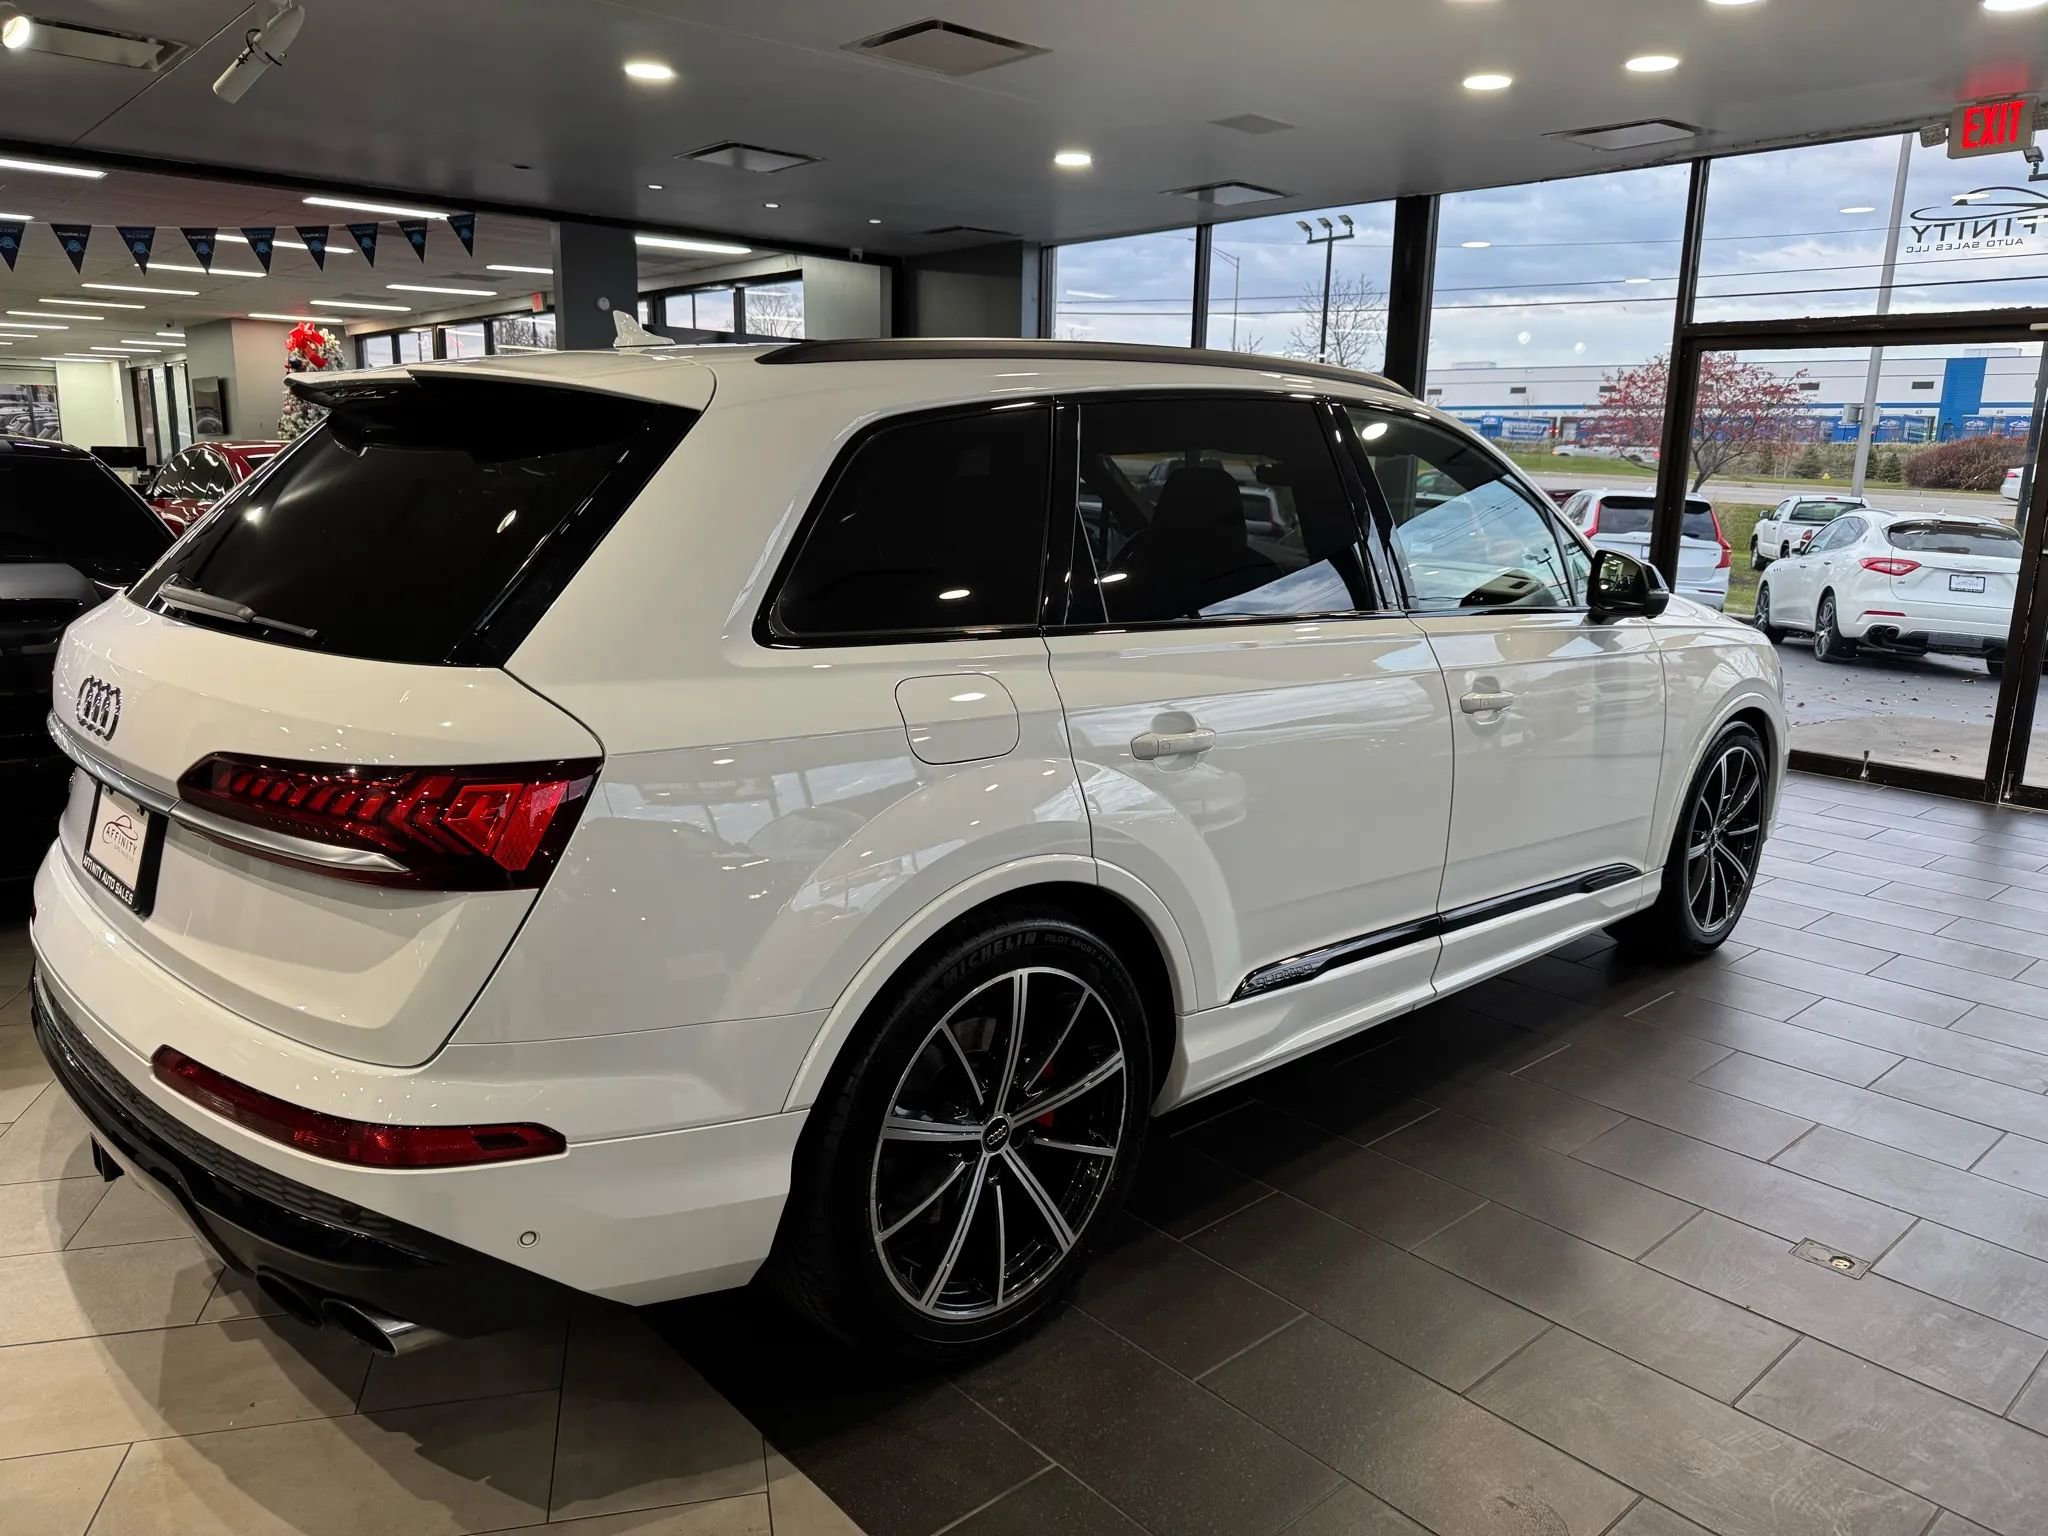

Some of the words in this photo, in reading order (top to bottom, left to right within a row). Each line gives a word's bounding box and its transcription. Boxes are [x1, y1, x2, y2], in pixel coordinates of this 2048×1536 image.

[1960, 99, 2027, 149] EXIT
[105, 826, 138, 856] AFFINITY
[83, 855, 103, 880] AFFINITY
[101, 871, 116, 891] AUTO
[114, 883, 134, 905] SALES
[942, 931, 1037, 987] MICHELIN
[1044, 933, 1070, 946] PILOT
